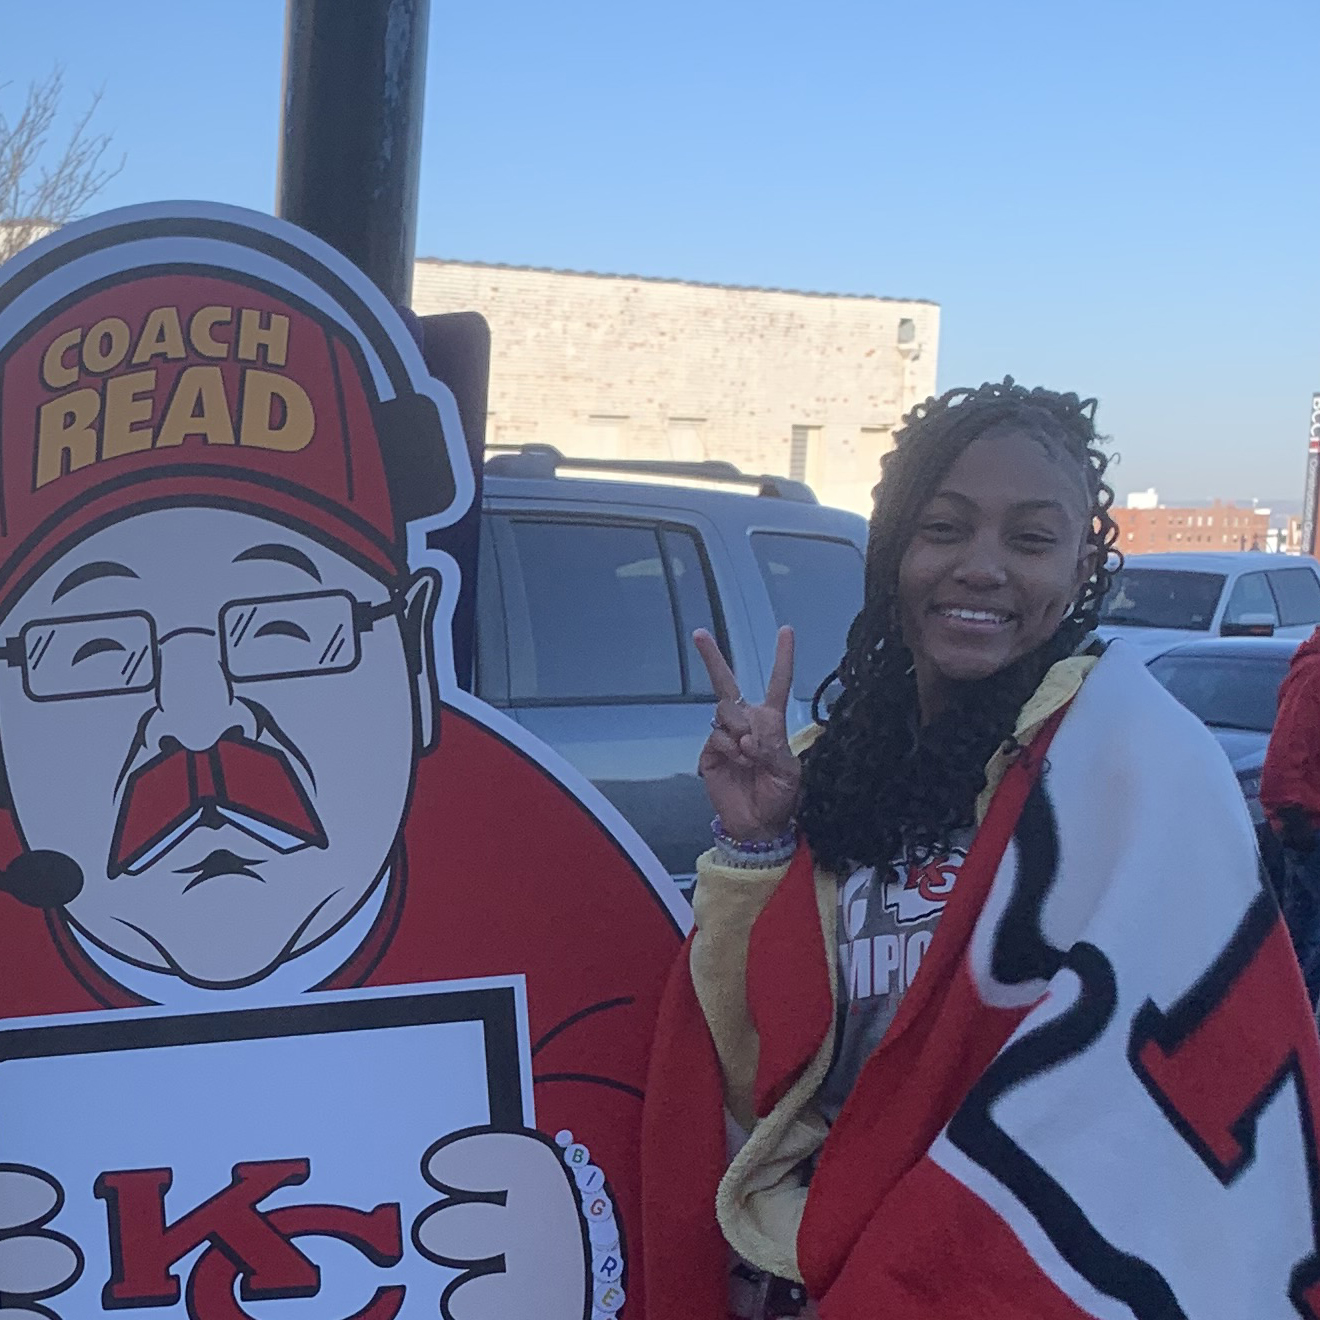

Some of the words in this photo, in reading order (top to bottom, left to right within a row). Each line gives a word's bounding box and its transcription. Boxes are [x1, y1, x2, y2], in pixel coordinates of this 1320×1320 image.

[42, 305, 290, 389] COACH
[34, 365, 316, 490] READ
[571, 1148, 606, 1216] BIG
